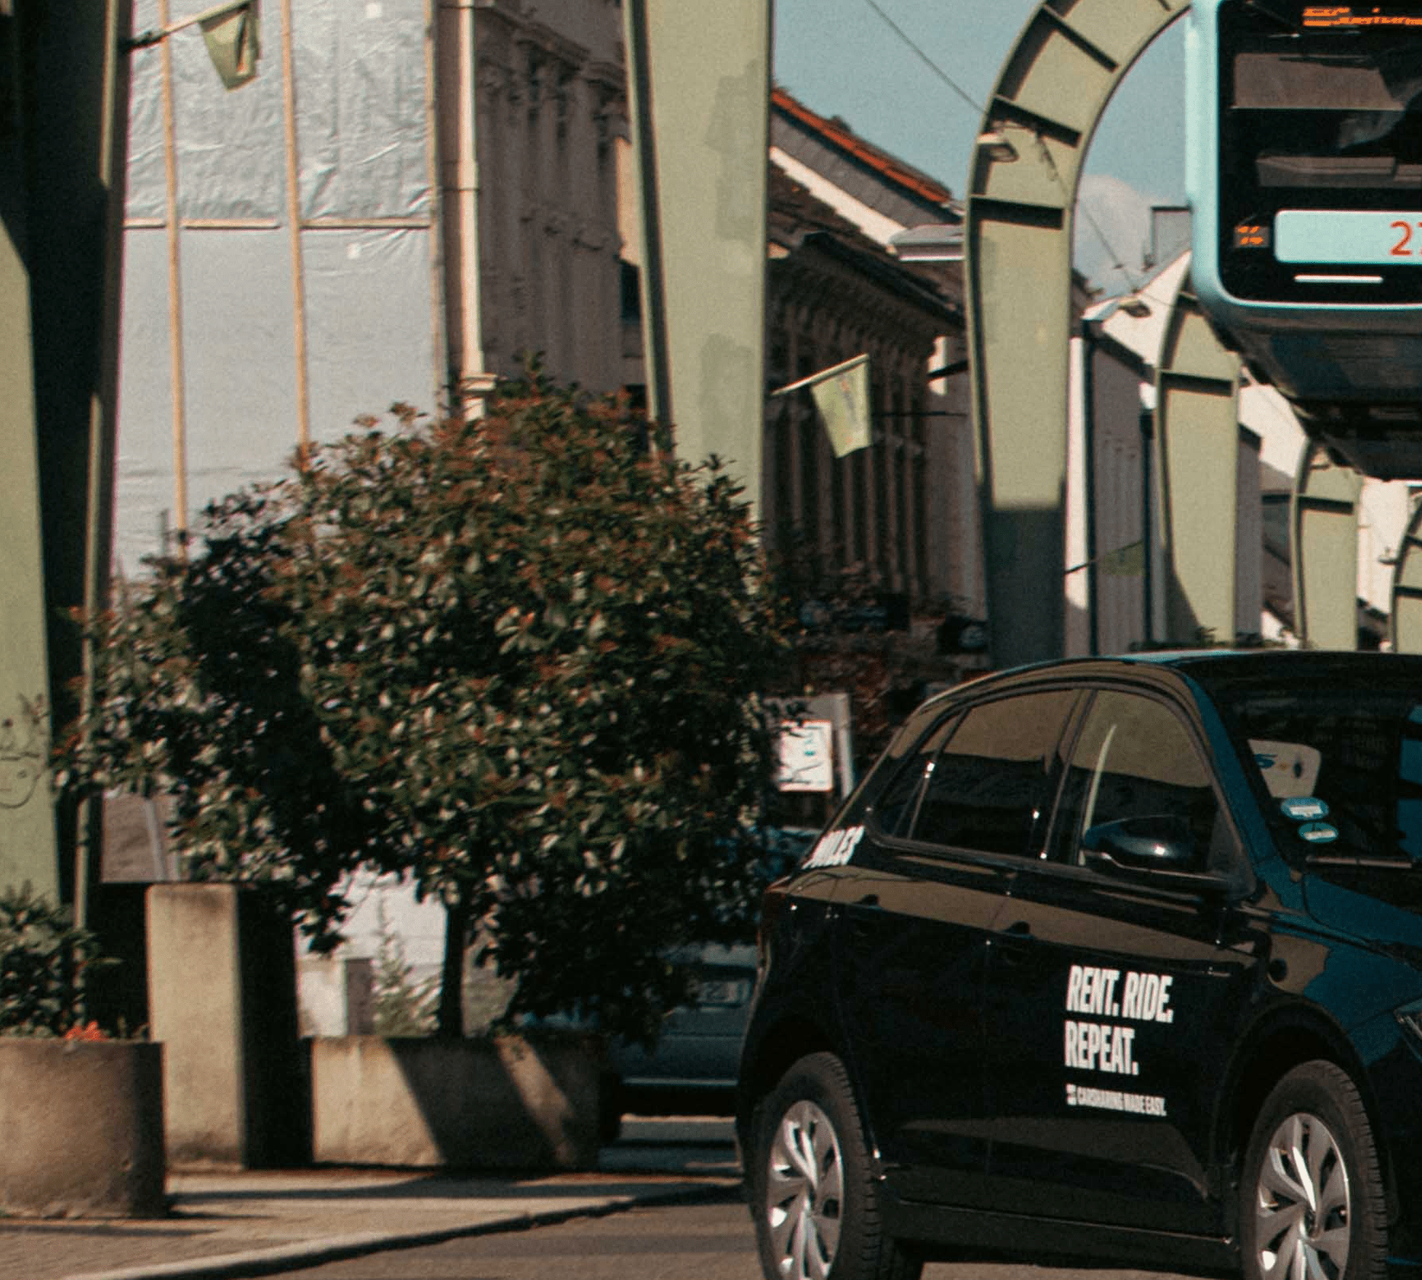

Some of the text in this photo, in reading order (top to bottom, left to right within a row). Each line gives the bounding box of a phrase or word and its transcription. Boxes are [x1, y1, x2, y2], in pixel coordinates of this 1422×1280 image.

[1066, 964, 1174, 1024] RENT. RIDE.
[1064, 1019, 1139, 1076] REPEAT.
